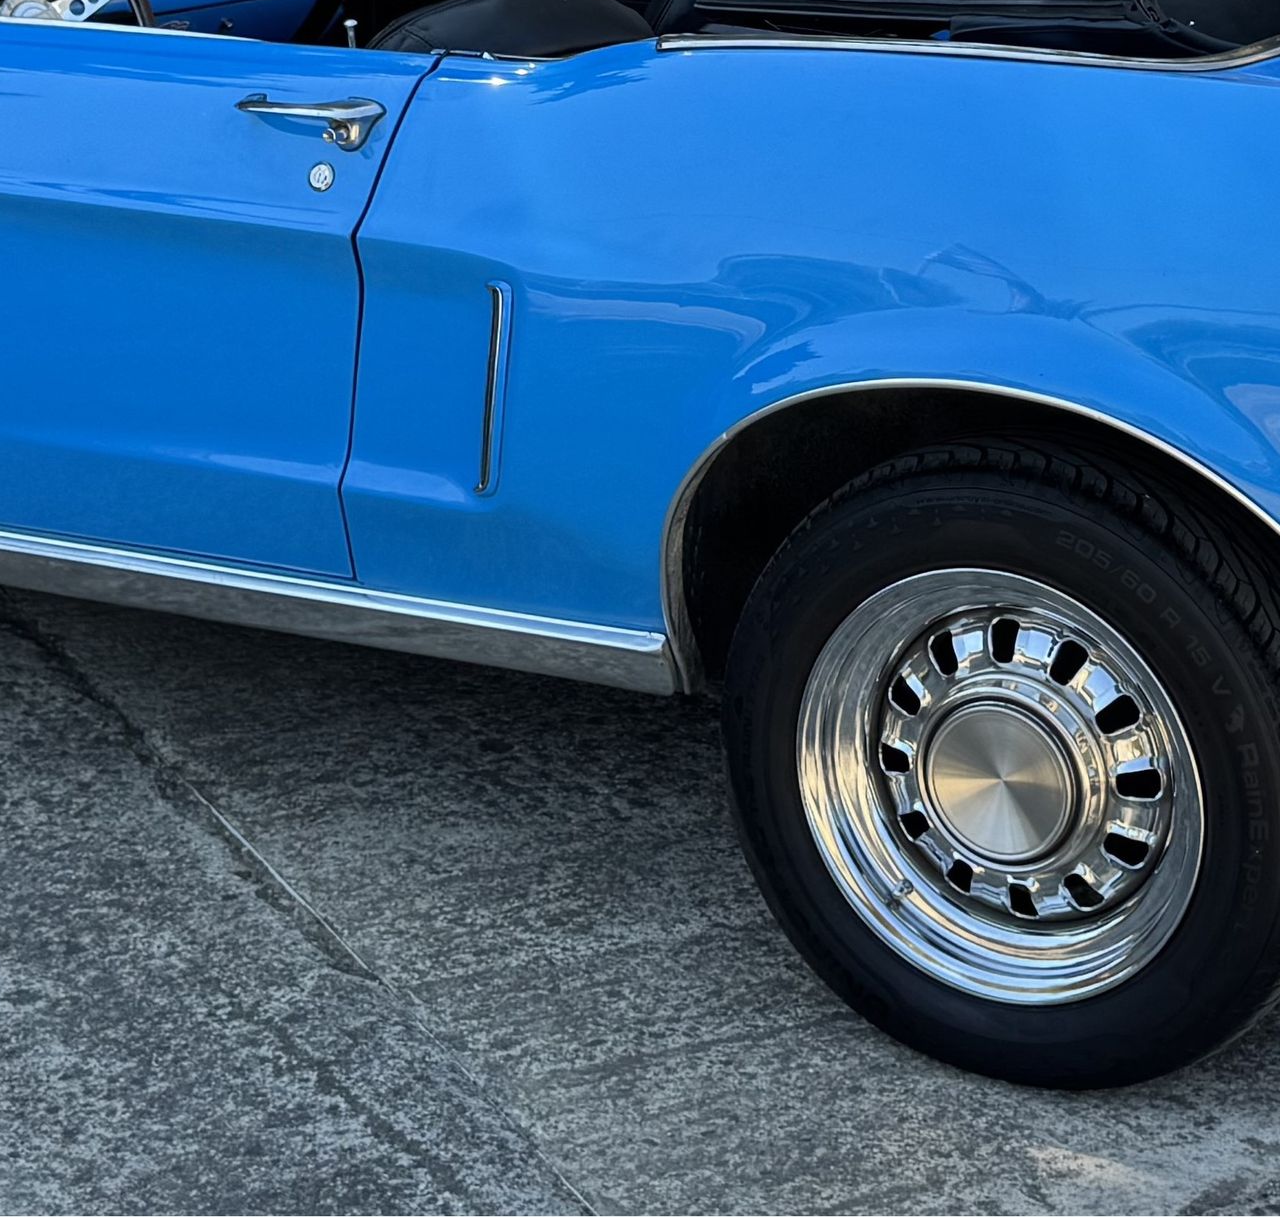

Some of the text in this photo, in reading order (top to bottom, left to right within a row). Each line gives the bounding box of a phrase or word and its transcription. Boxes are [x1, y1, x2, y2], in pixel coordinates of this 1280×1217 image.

[1053, 529, 1234, 698] 205/60 R 15 V
